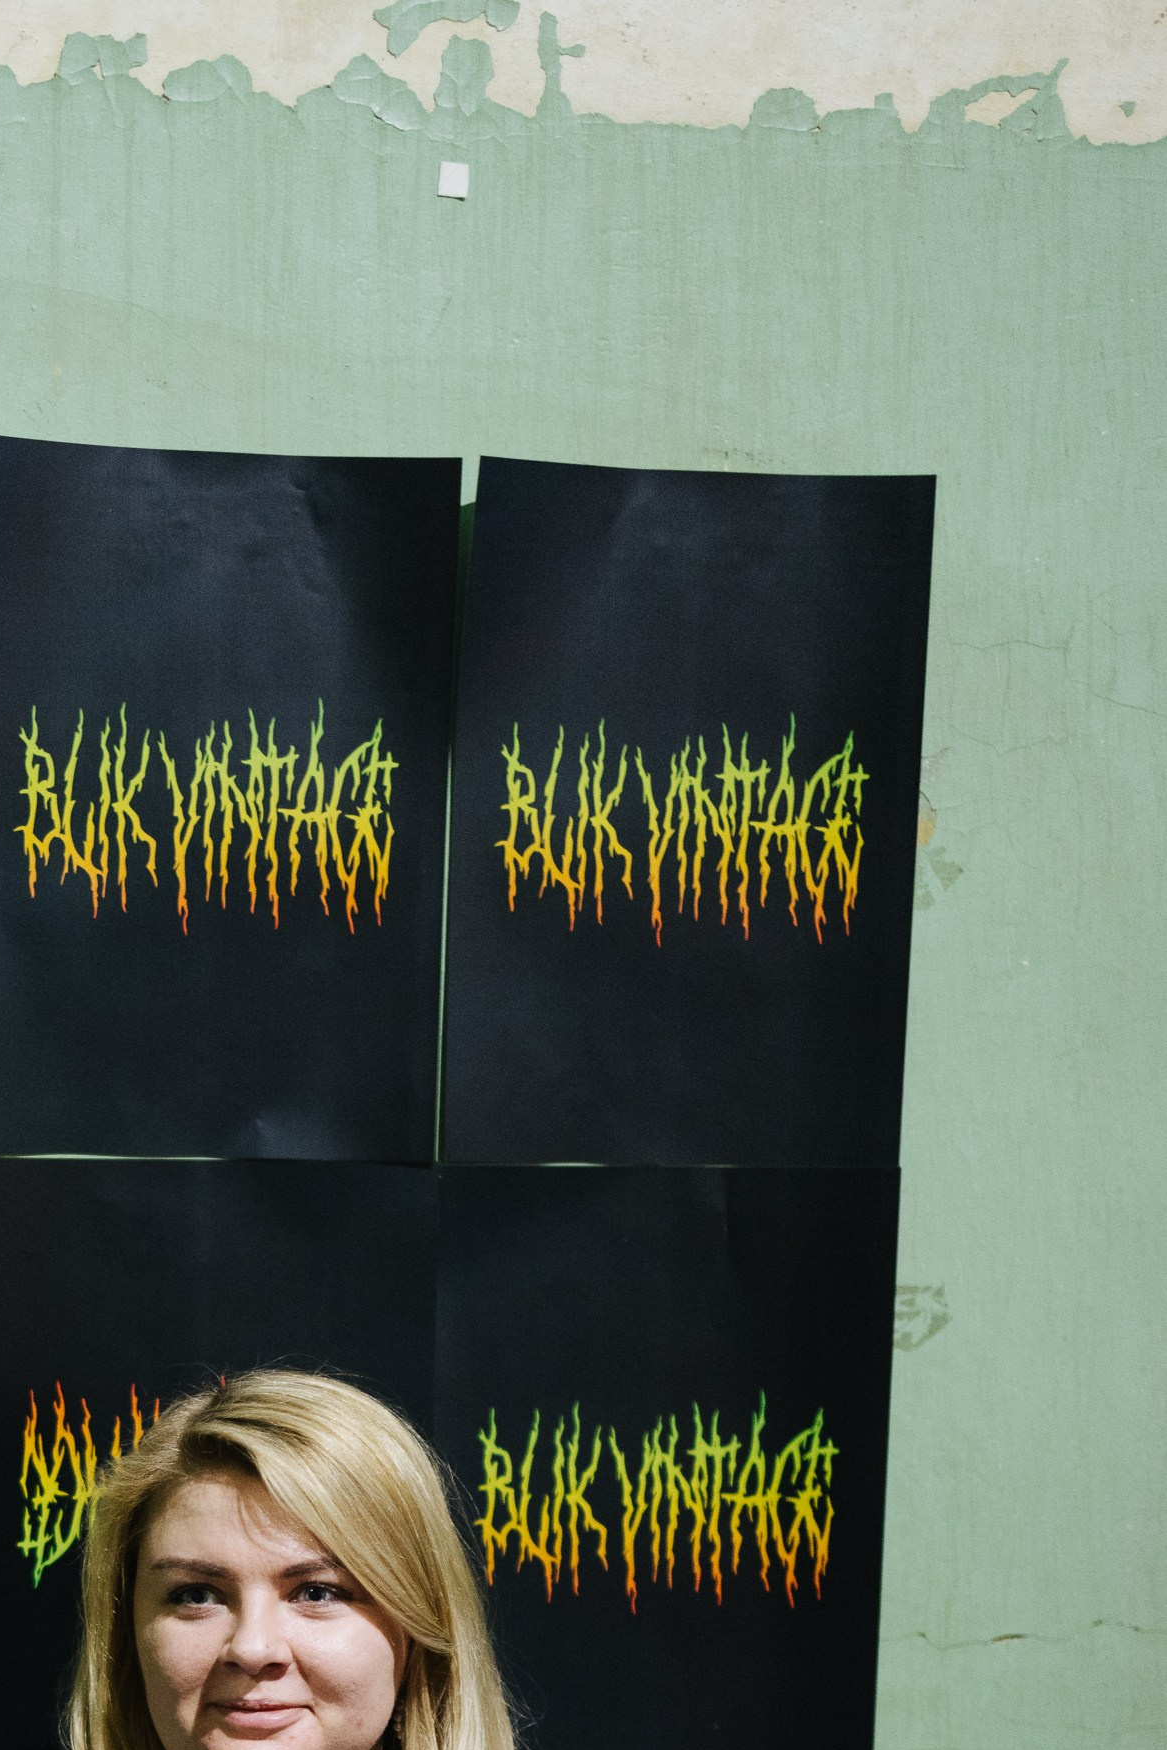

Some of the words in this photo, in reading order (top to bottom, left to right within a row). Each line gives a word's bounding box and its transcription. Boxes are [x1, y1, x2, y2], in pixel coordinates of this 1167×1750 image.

[13, 703, 159, 919] BLIK
[158, 699, 399, 936] VINTAGE
[494, 719, 634, 932] BLIK
[633, 712, 870, 947] VINTAGE
[473, 1402, 609, 1604] BLIK
[607, 1391, 840, 1616] VINTAGE
